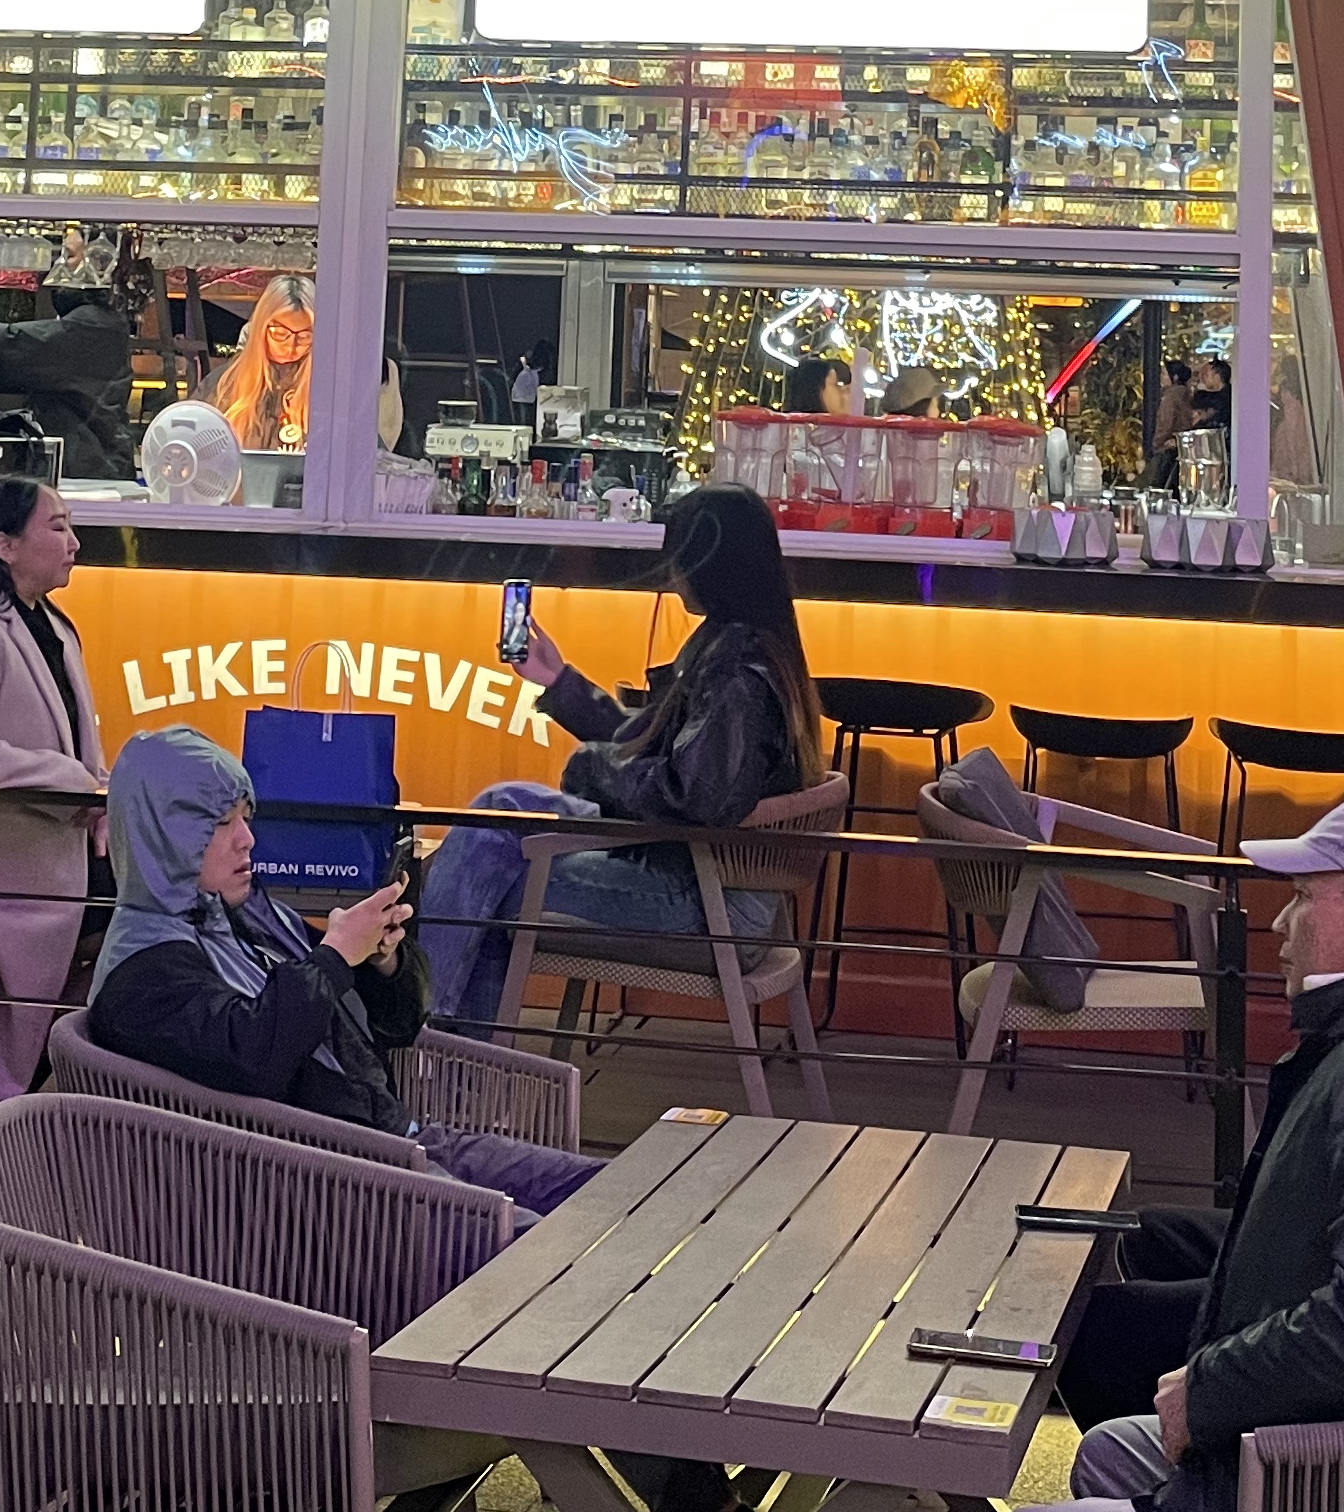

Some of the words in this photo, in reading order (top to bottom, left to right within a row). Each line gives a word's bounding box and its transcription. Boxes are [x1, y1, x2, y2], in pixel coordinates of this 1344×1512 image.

[122, 639, 287, 716] LIKE
[324, 639, 553, 748] NEVER
[305, 863, 359, 877] REVIVO
